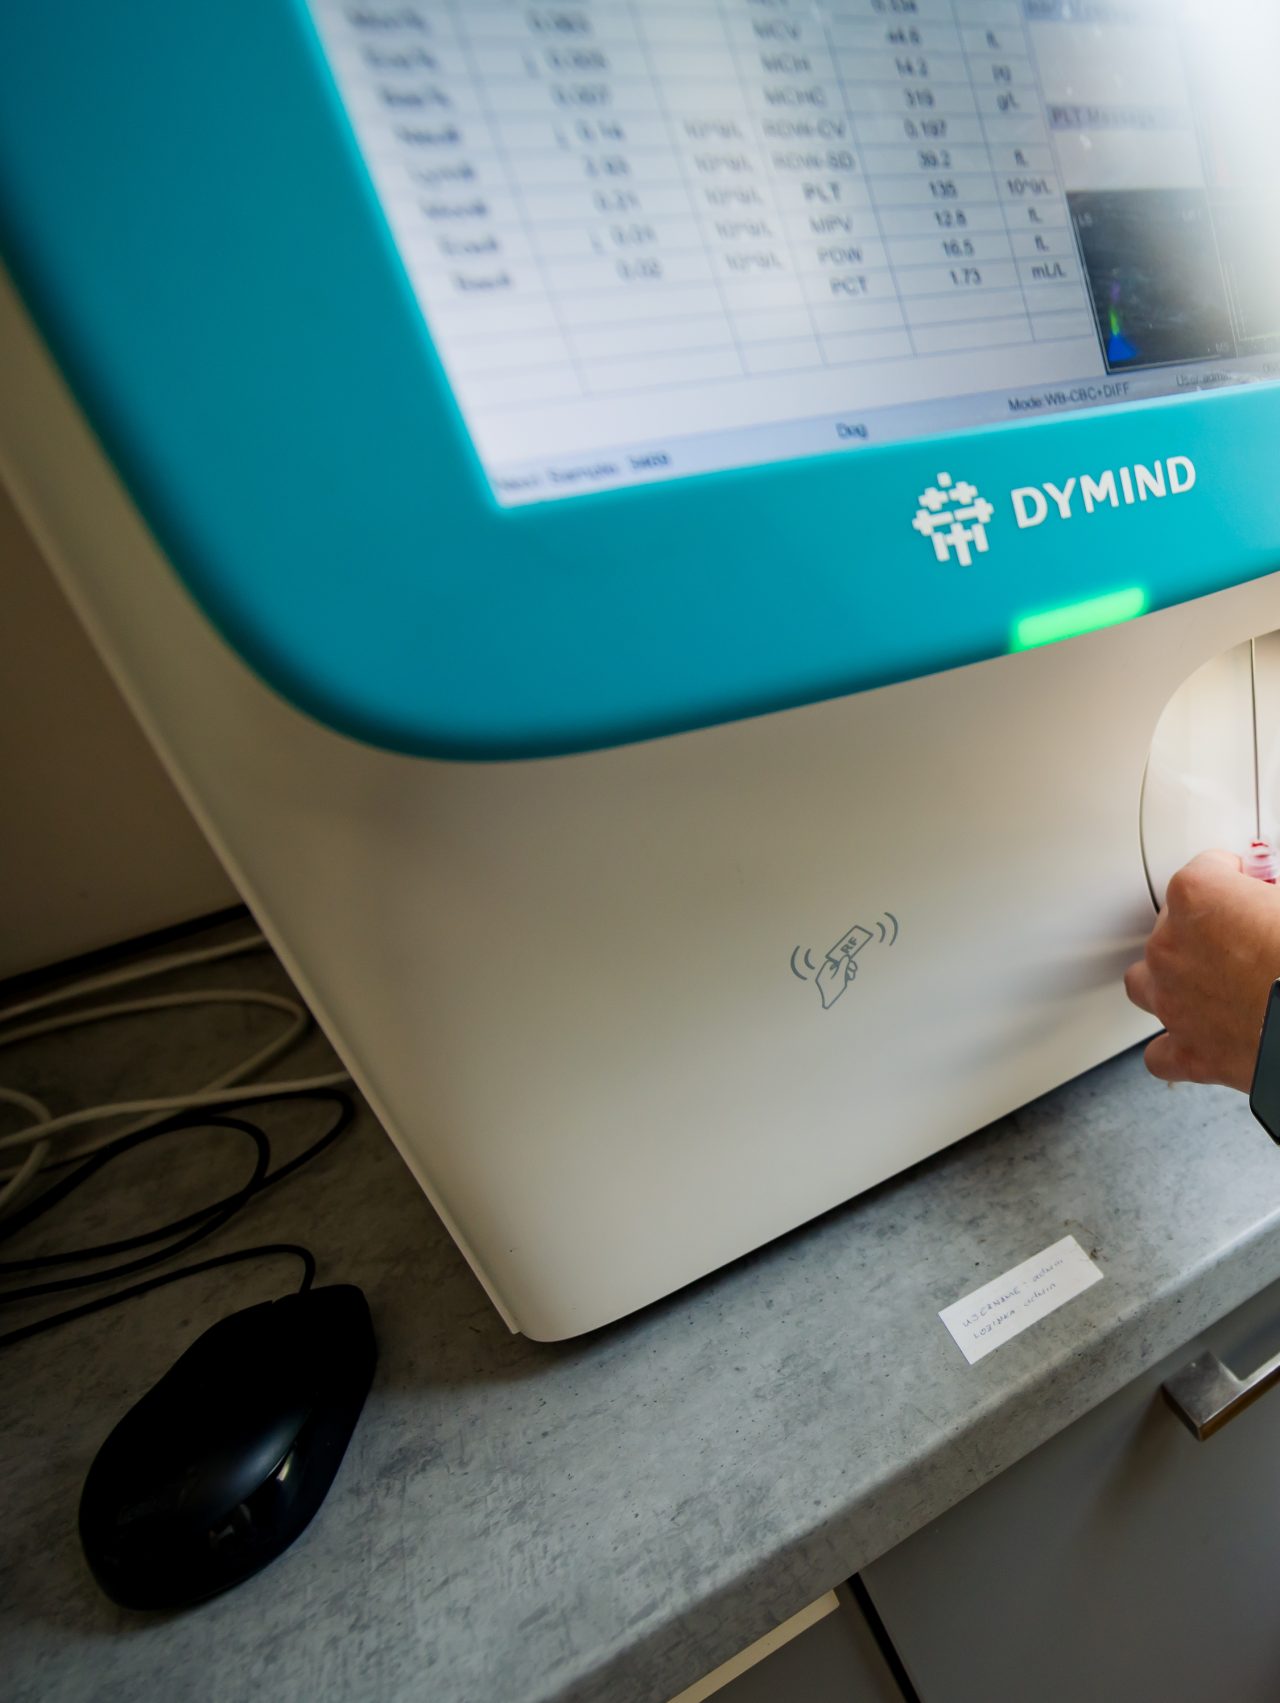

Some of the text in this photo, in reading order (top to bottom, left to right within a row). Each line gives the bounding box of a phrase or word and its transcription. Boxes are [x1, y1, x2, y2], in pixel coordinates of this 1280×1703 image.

[802, 181, 841, 202] PLT
[809, 213, 853, 233] MPV
[816, 245, 864, 265] PDW
[829, 275, 869, 296] PCT
[949, 266, 982, 286] 1.73
[1011, 455, 1197, 530] DYMIND
[840, 936, 858, 953] RF
